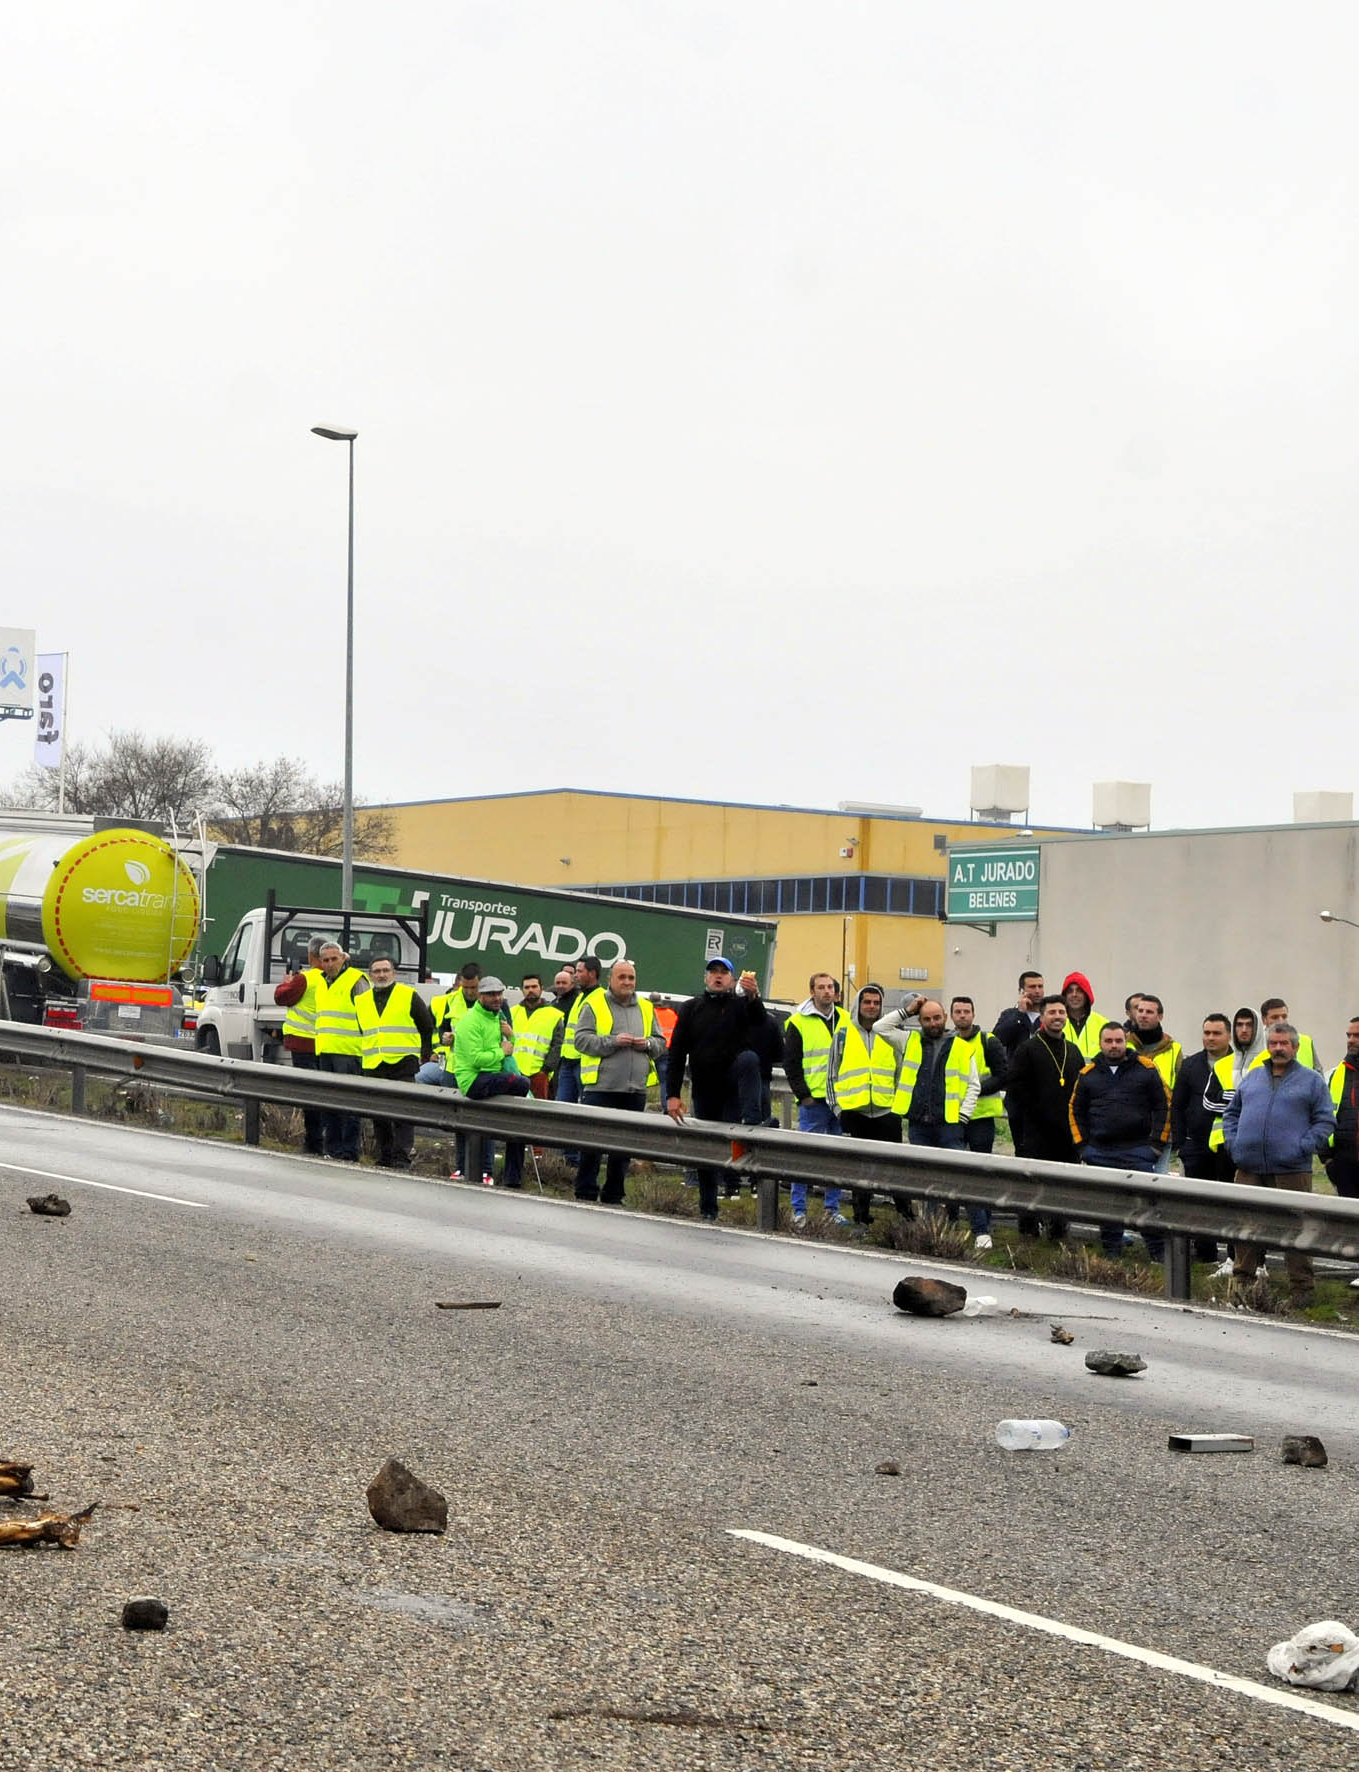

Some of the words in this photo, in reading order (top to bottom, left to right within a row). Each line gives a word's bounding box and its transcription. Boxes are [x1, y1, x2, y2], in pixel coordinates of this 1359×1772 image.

[954, 862, 976, 883] A.T
[981, 861, 1035, 881] JURADO
[440, 894, 518, 917] Transportes
[969, 892, 1016, 908] BELENES
[427, 909, 627, 969] JURADO
